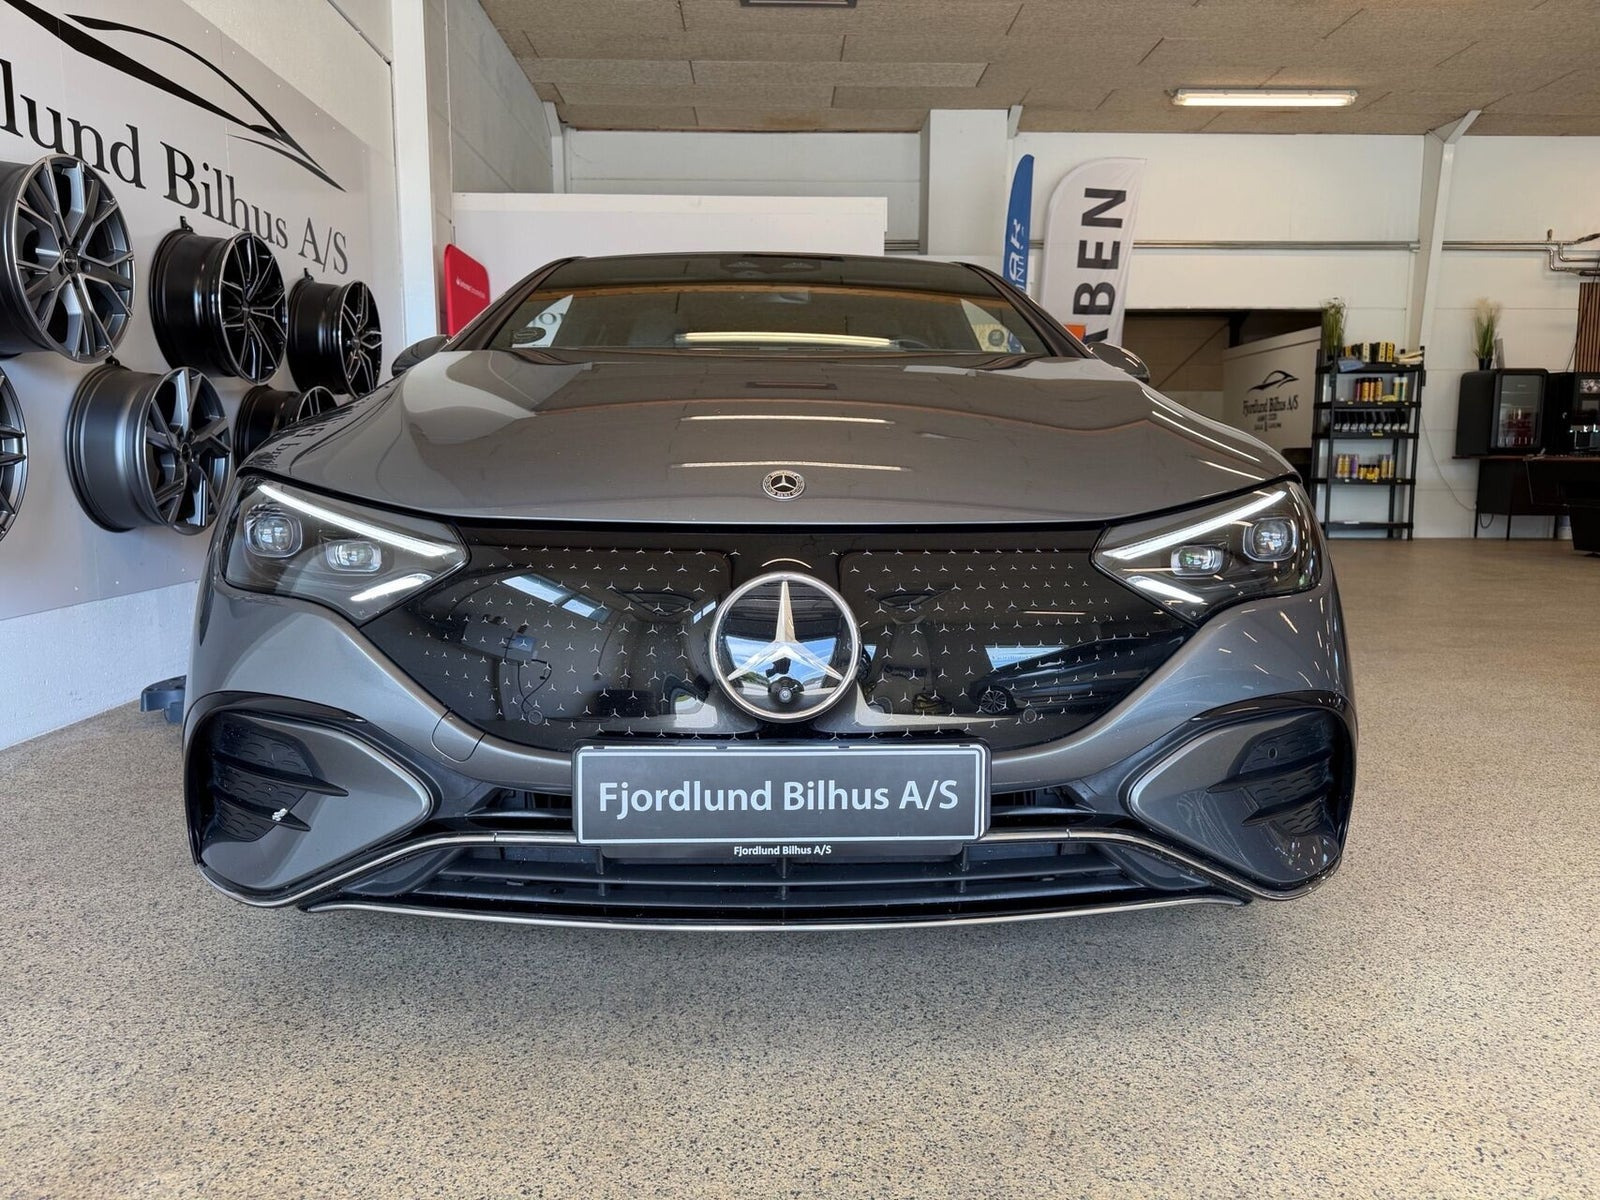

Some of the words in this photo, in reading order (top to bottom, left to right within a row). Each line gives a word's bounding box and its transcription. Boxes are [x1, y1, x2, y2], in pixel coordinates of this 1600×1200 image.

[160, 141, 289, 249] Bilhus
[298, 217, 348, 275] A/S
[599, 780, 772, 820] Fjordlund
[783, 779, 890, 811] Bilhus
[898, 779, 959, 811] A/S
[733, 845, 781, 857] Fjordlund
[782, 845, 812, 856] Bilhus
[813, 844, 832, 856] A/S
